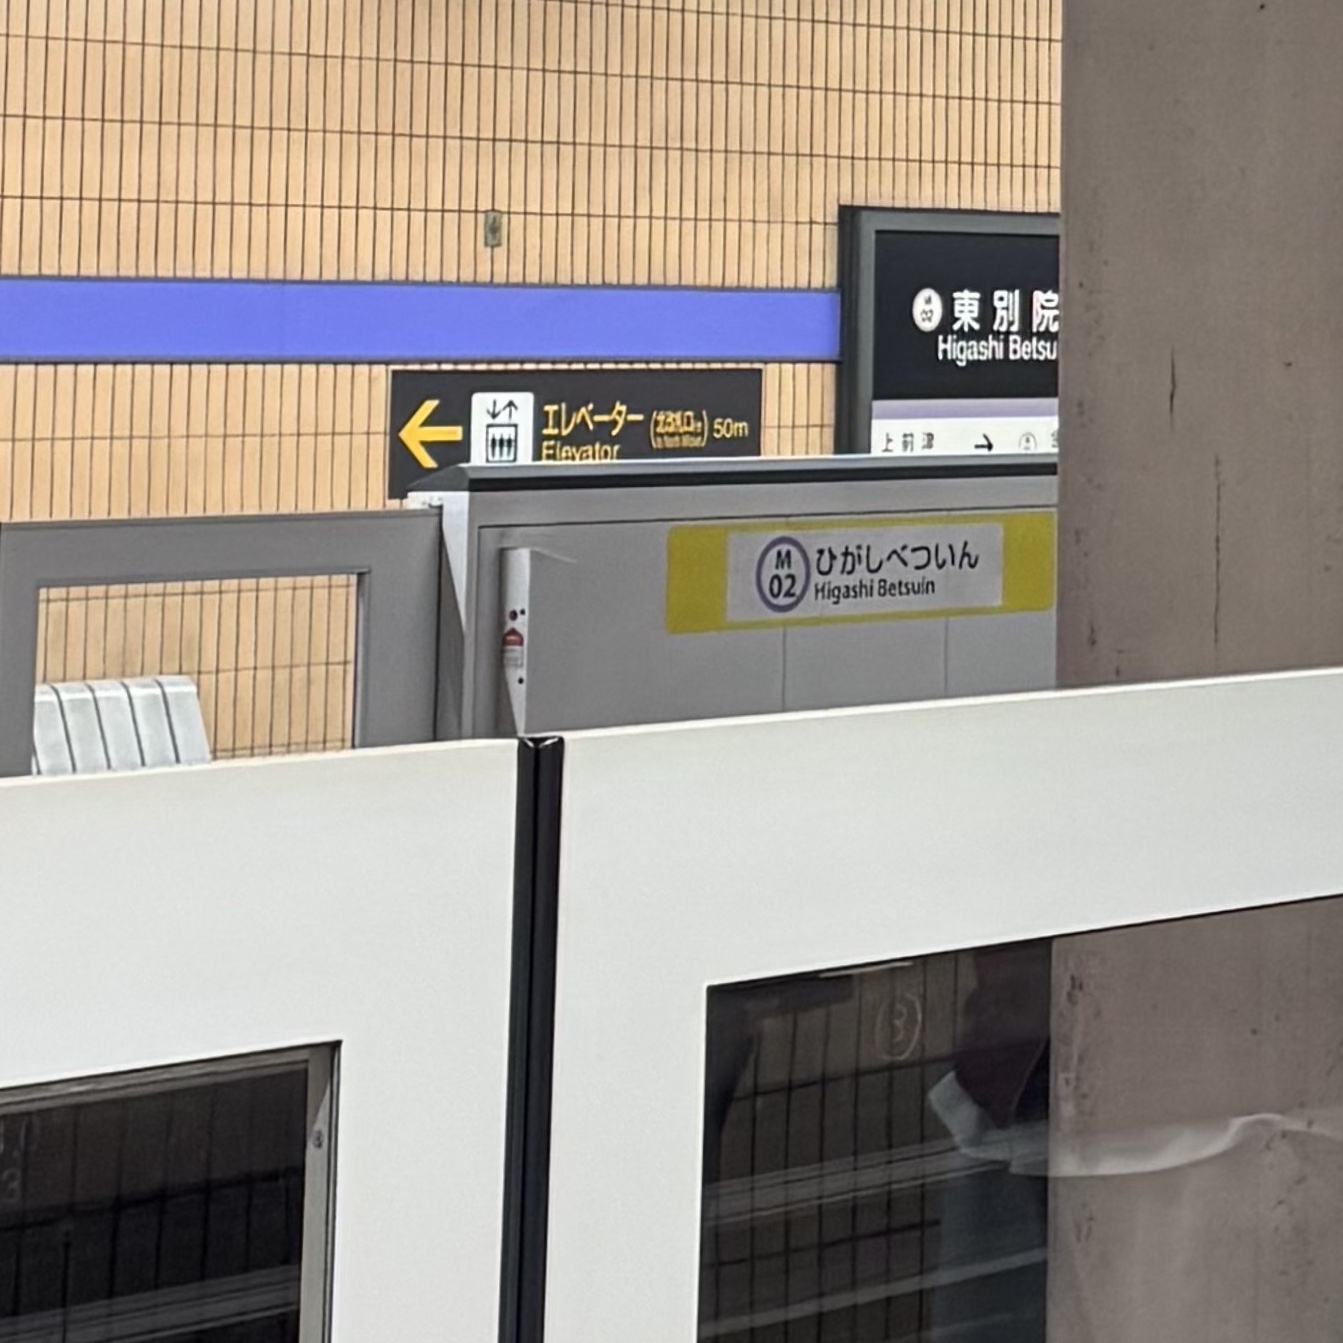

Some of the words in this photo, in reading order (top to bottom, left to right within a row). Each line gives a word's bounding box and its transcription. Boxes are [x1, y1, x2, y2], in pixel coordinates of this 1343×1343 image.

[952, 288, 1059, 333] 東別院
[937, 334, 1004, 367] Higashi
[542, 400, 644, 437] エレベーター
[713, 418, 749, 439] 50m
[774, 549, 792, 570] M
[815, 540, 980, 577] ひがしべついん
[768, 573, 797, 599] 02
[814, 578, 875, 605] Higashi
[877, 576, 936, 598] Betsuin
